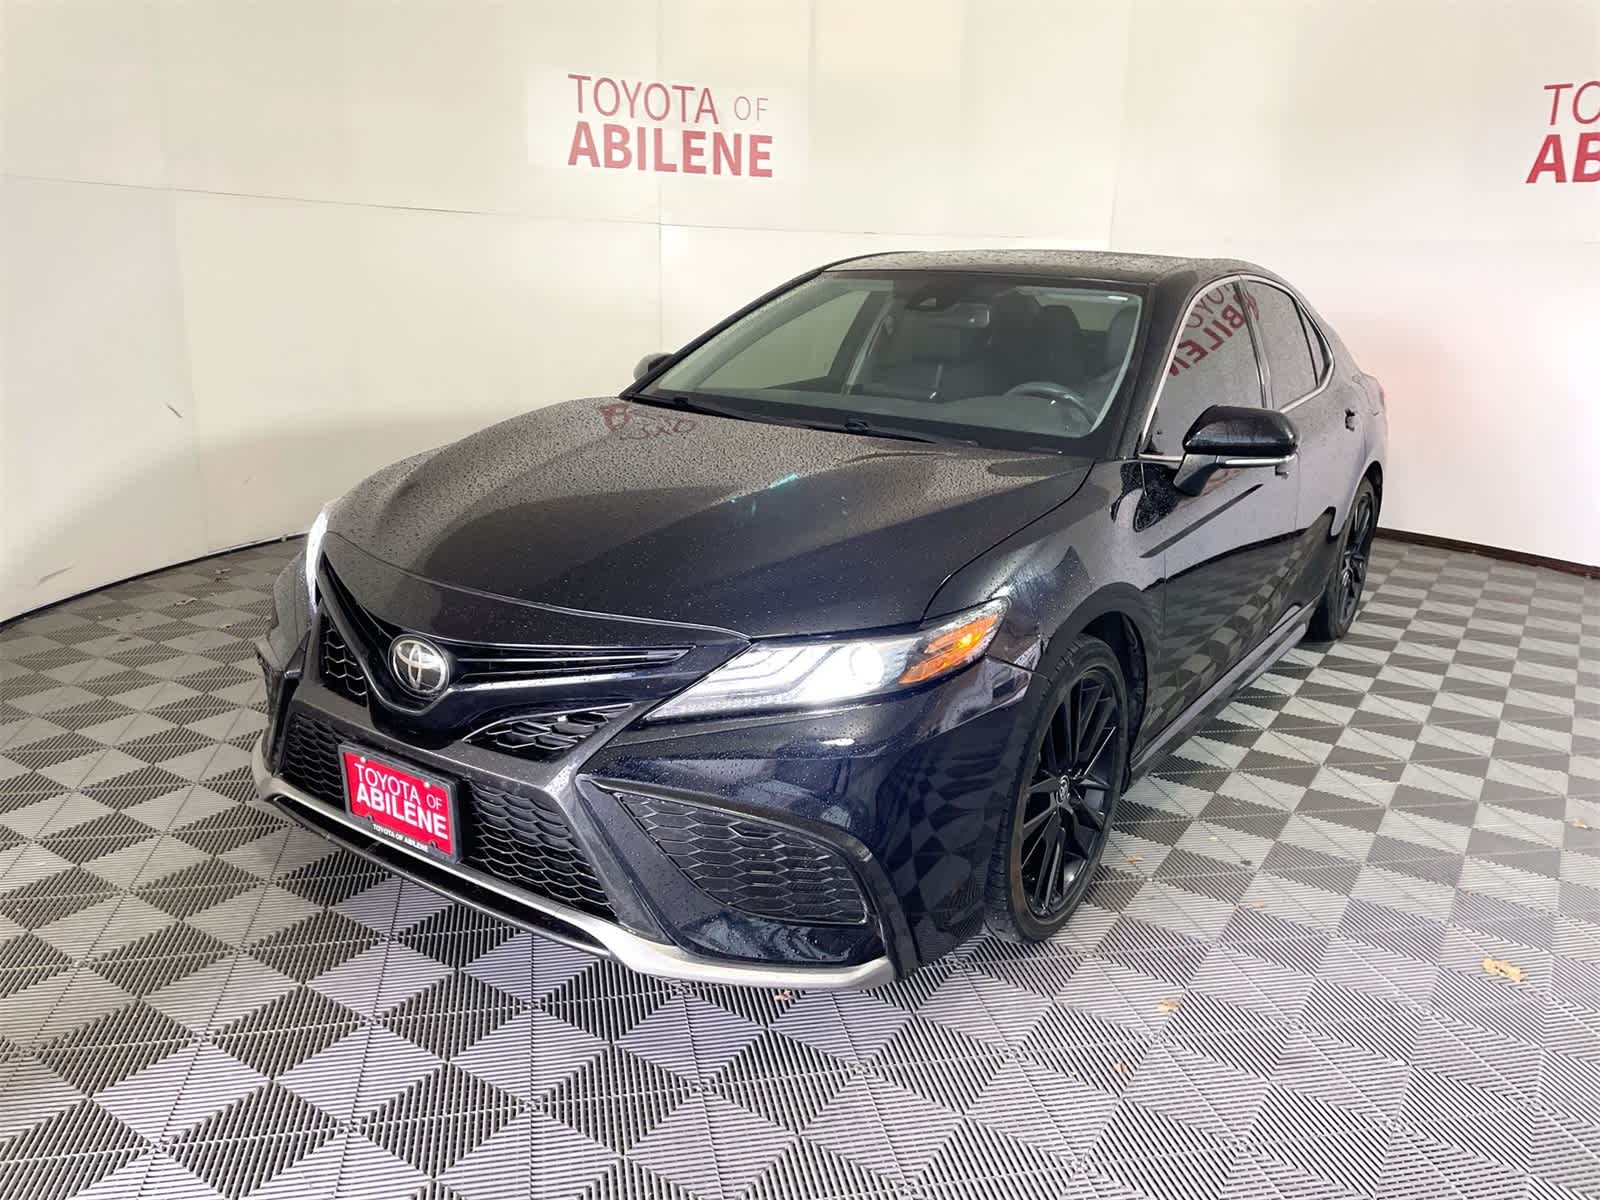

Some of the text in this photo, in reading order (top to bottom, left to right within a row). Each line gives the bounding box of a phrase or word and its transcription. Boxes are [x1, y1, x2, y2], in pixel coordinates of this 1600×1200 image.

[568, 73, 768, 125] TOYOTA OF
[567, 120, 773, 178] ABILENE
[354, 762, 442, 810] TOYOTA OF
[356, 782, 448, 840] ABILENE
[373, 823, 395, 838] TOYOTA
